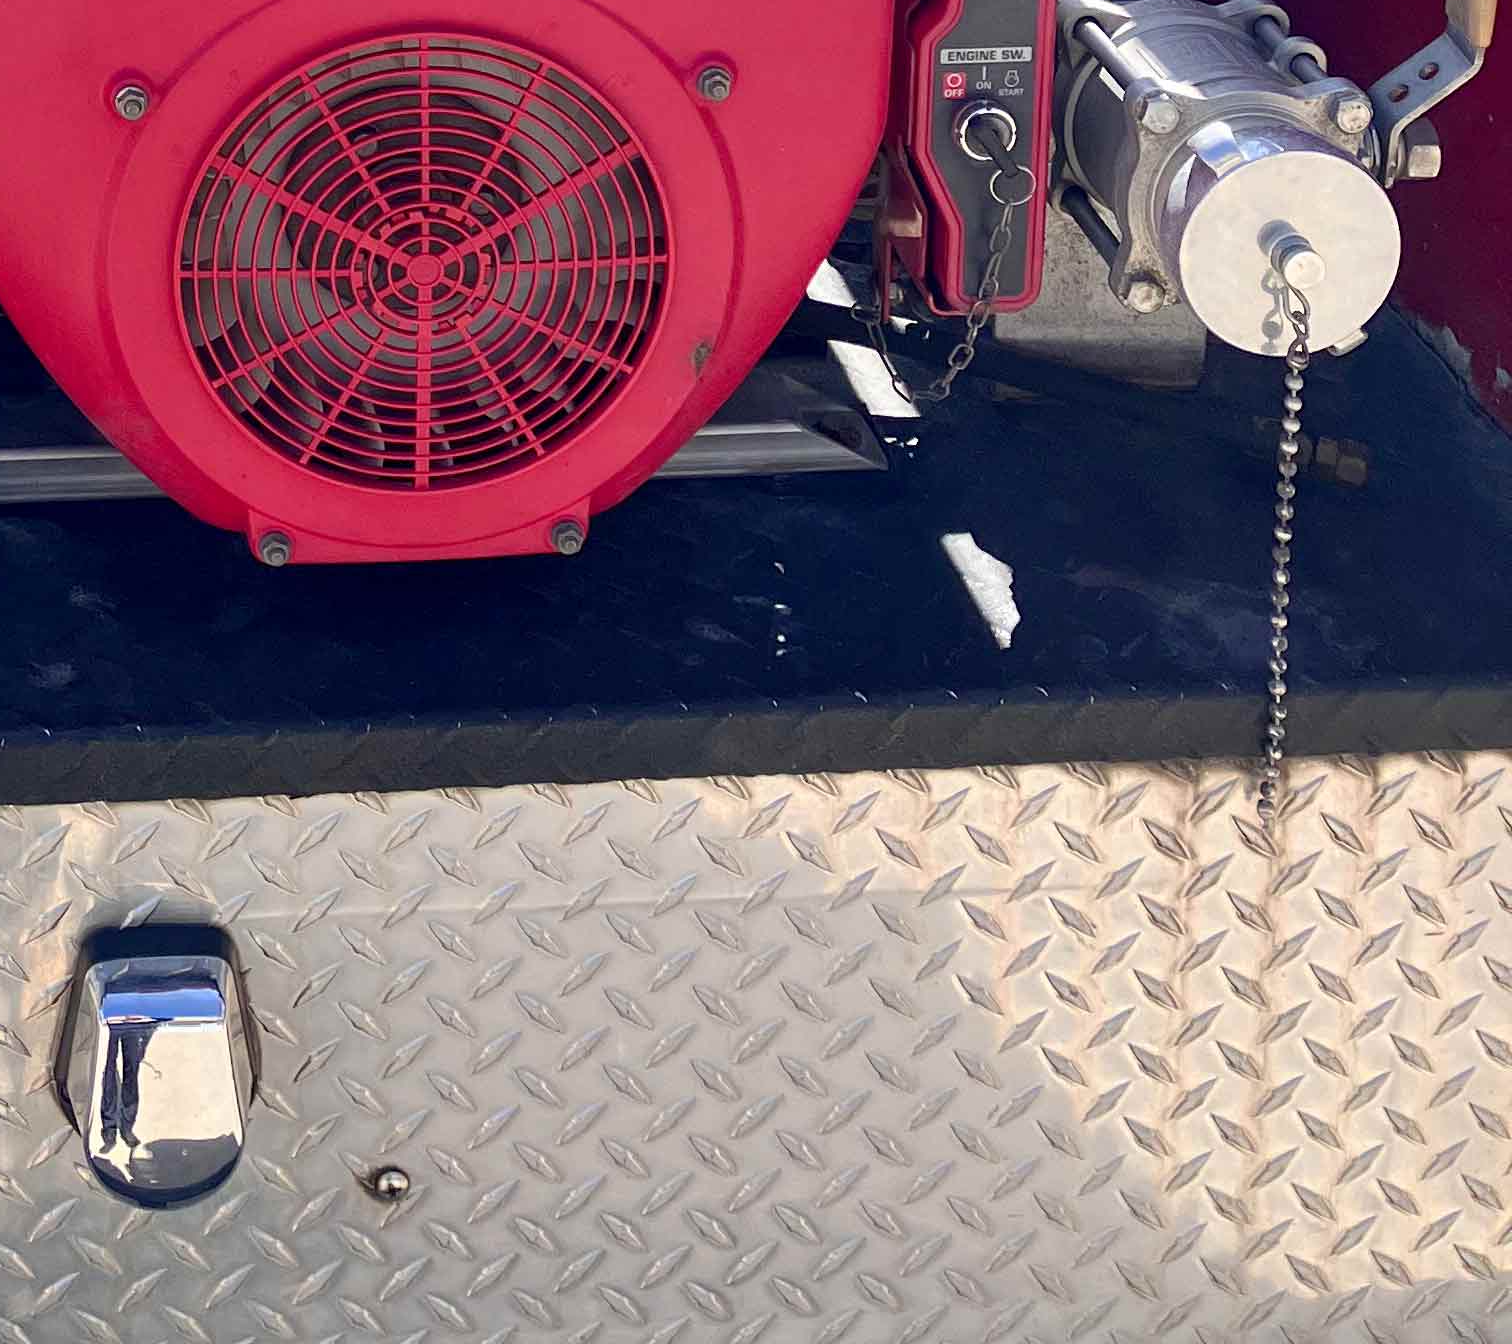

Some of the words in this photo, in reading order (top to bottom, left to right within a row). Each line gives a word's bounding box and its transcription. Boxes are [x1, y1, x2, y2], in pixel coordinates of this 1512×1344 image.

[947, 50, 997, 62] ENGINE
[1001, 49, 1027, 61] SW.
[975, 80, 992, 90] ON
[944, 88, 966, 99] OFF
[998, 88, 1024, 97] START
